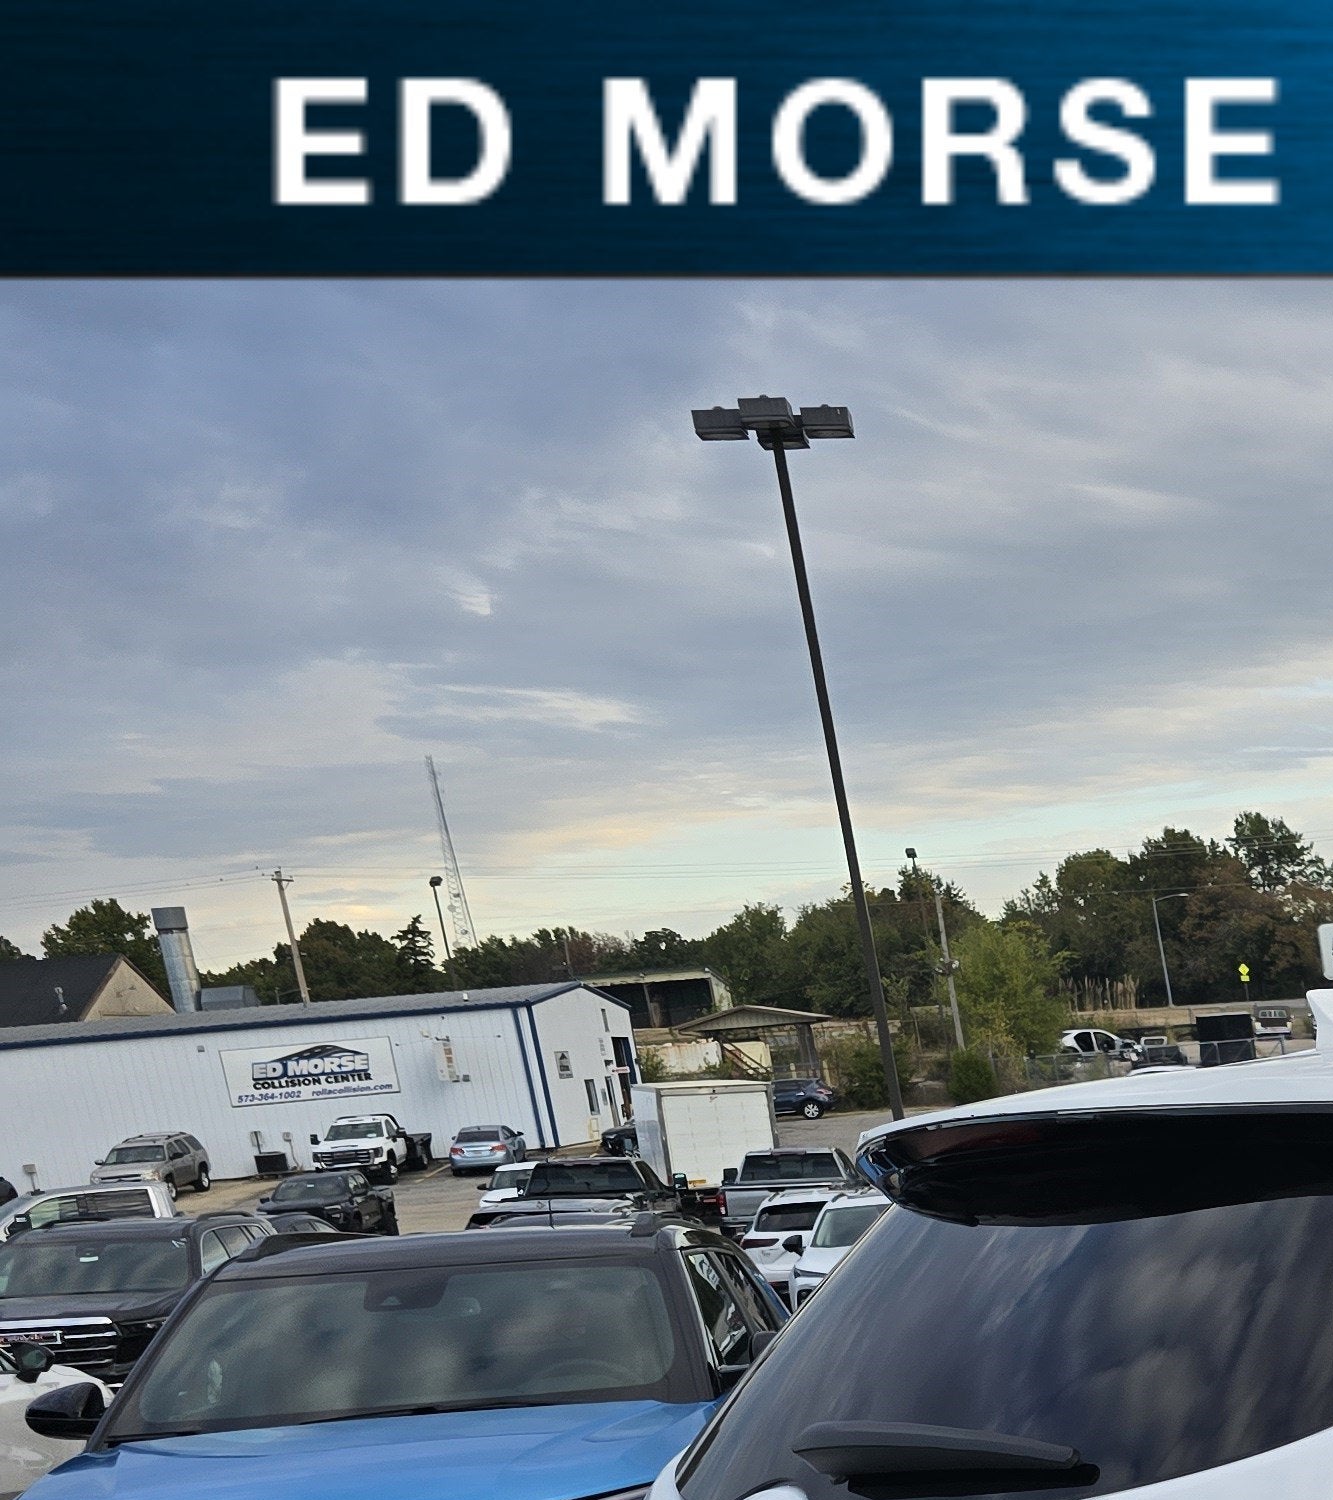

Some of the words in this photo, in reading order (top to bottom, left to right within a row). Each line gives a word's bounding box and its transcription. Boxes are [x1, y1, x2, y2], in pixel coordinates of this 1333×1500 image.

[252, 1062, 284, 1080] ED
[287, 1053, 369, 1078] MORSE
[253, 1076, 322, 1090] COLLISION
[325, 1072, 373, 1083] CENTER
[237, 1090, 302, 1103] 573-364-1002
